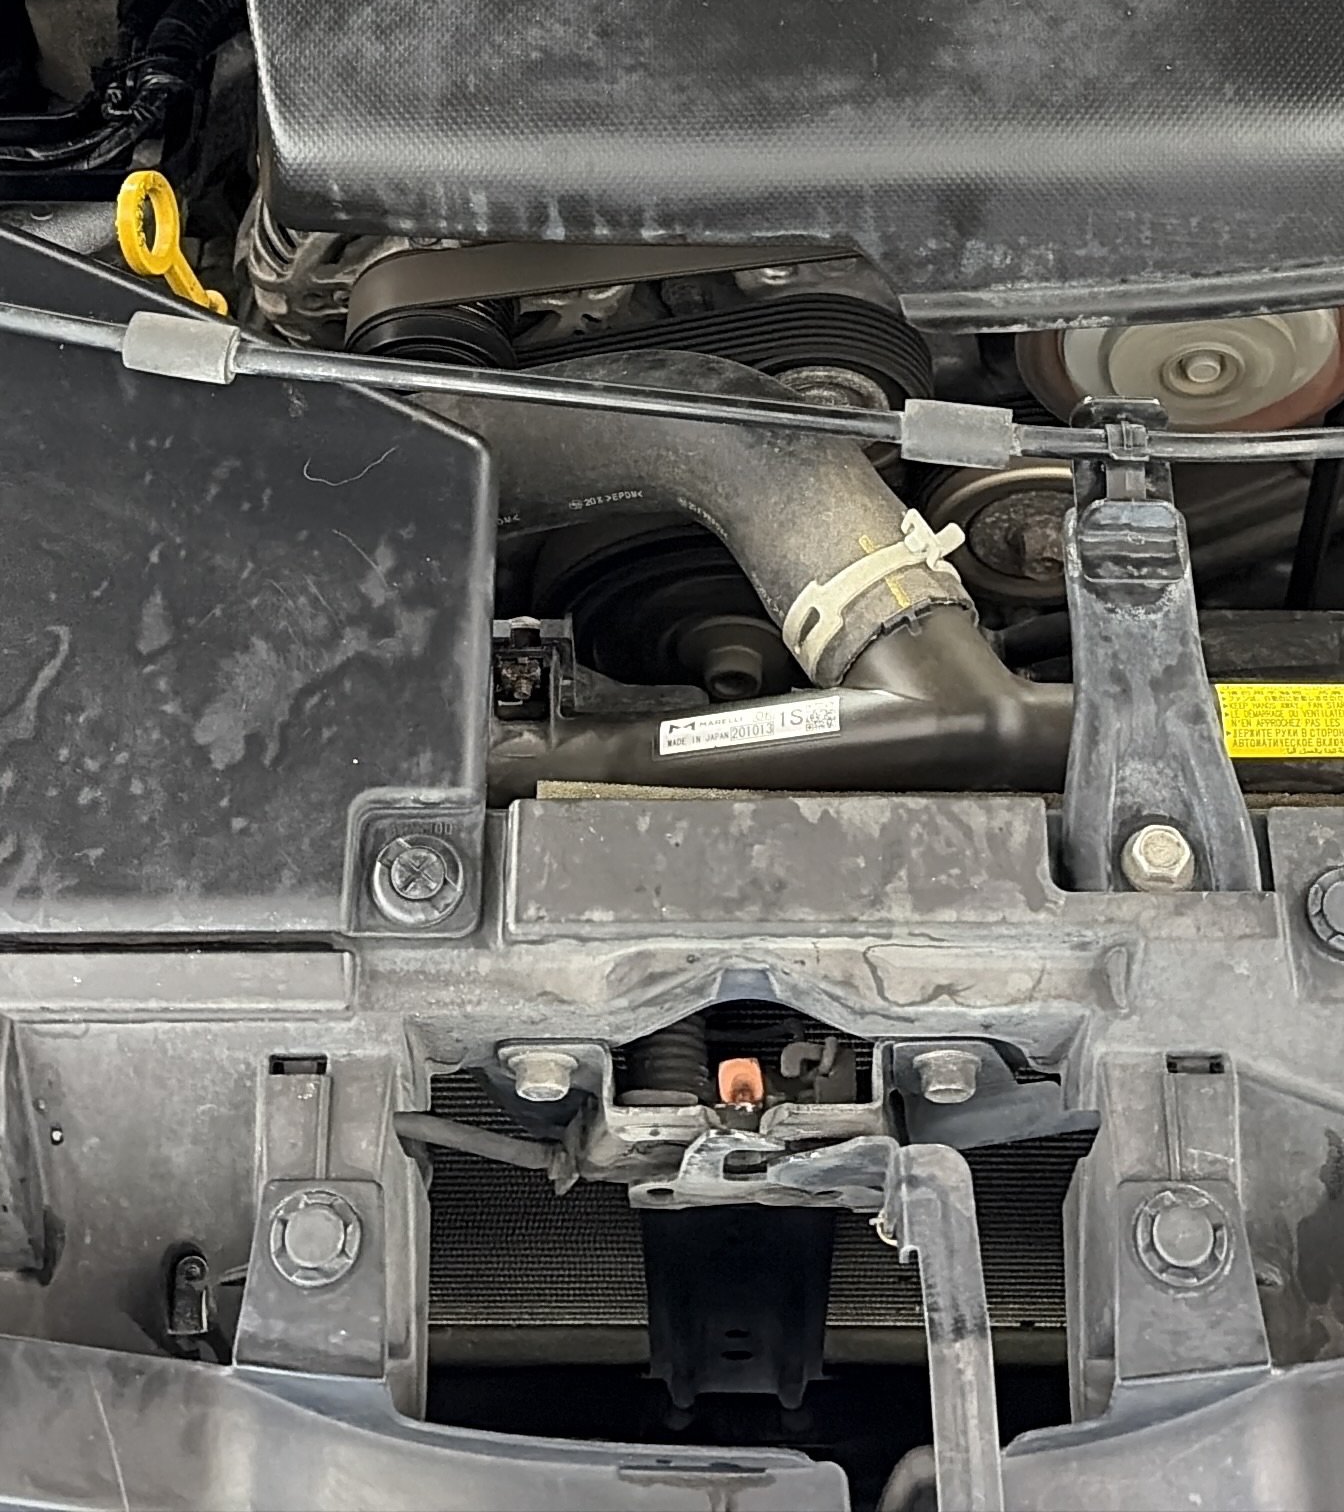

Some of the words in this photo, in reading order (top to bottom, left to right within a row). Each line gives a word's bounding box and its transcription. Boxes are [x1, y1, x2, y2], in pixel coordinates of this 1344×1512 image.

[1307, 701, 1323, 709] FAN
[1230, 710, 1240, 719] LE
[699, 717, 744, 727] MARELLI
[1231, 719, 1252, 728] N'EN
[1256, 719, 1301, 728] APPROCHEZ
[1305, 718, 1321, 727] PAS
[1325, 718, 1341, 727] LES
[667, 737, 687, 748] MADE
[692, 735, 701, 744] IN
[706, 731, 730, 743] JAPAN
[731, 722, 774, 739] 201013
[1233, 729, 1273, 738] ДЕРЖИТЕ
[1275, 729, 1301, 738] РУКИ
[1232, 738, 1314, 748] АВТОМАТИЧЕСКОЕ
